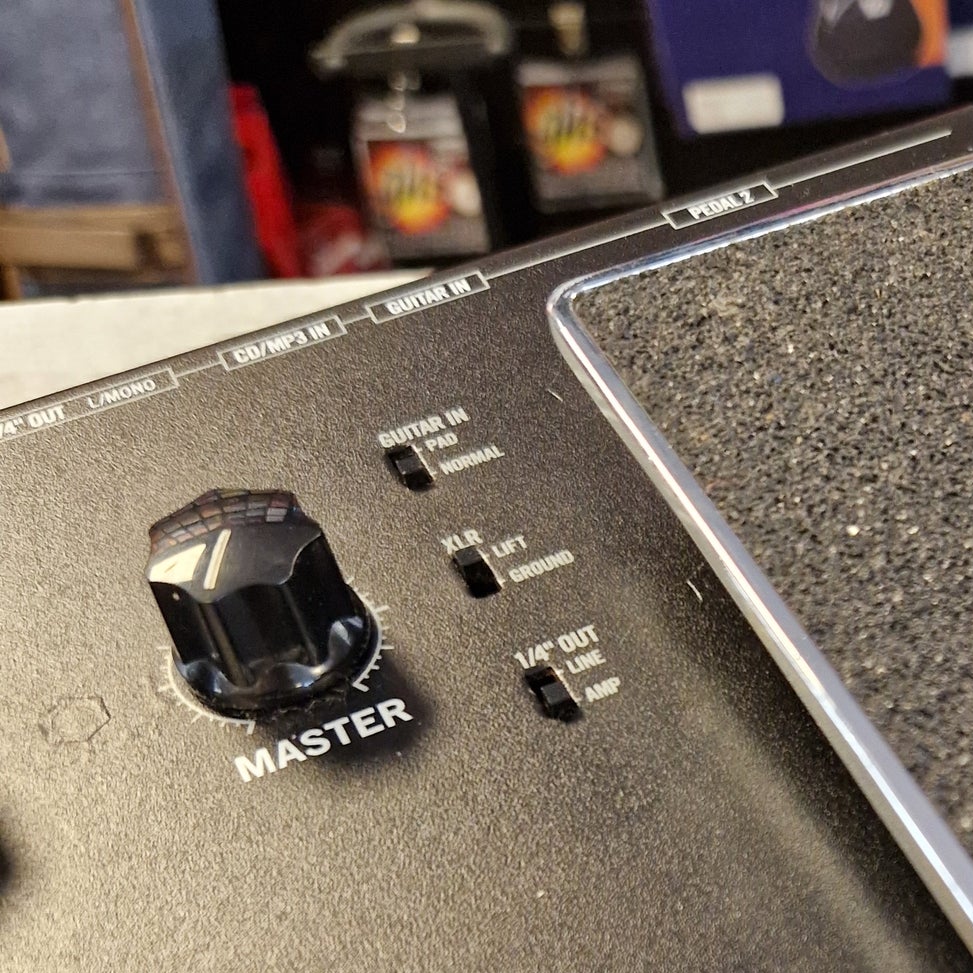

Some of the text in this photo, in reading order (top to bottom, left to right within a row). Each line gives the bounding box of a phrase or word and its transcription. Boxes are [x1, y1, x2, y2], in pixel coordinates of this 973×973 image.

[688, 191, 754, 219] PEDAL 2
[385, 278, 471, 316] GUITAR IN
[233, 322, 331, 364] CD/MP3 IN
[27, 405, 65, 428] OUT
[86, 379, 156, 409] L/MONO
[378, 406, 470, 449] GUITAR IN
[425, 432, 459, 452] PAD
[440, 445, 505, 476] NORMAL
[440, 528, 483, 555] XLR
[491, 535, 528, 559] LIFT
[508, 549, 575, 584] GROUND
[514, 624, 600, 670] 1/4" OUT
[566, 649, 606, 675] LINE
[584, 676, 622, 703] AMP
[233, 698, 414, 783] MASTER
